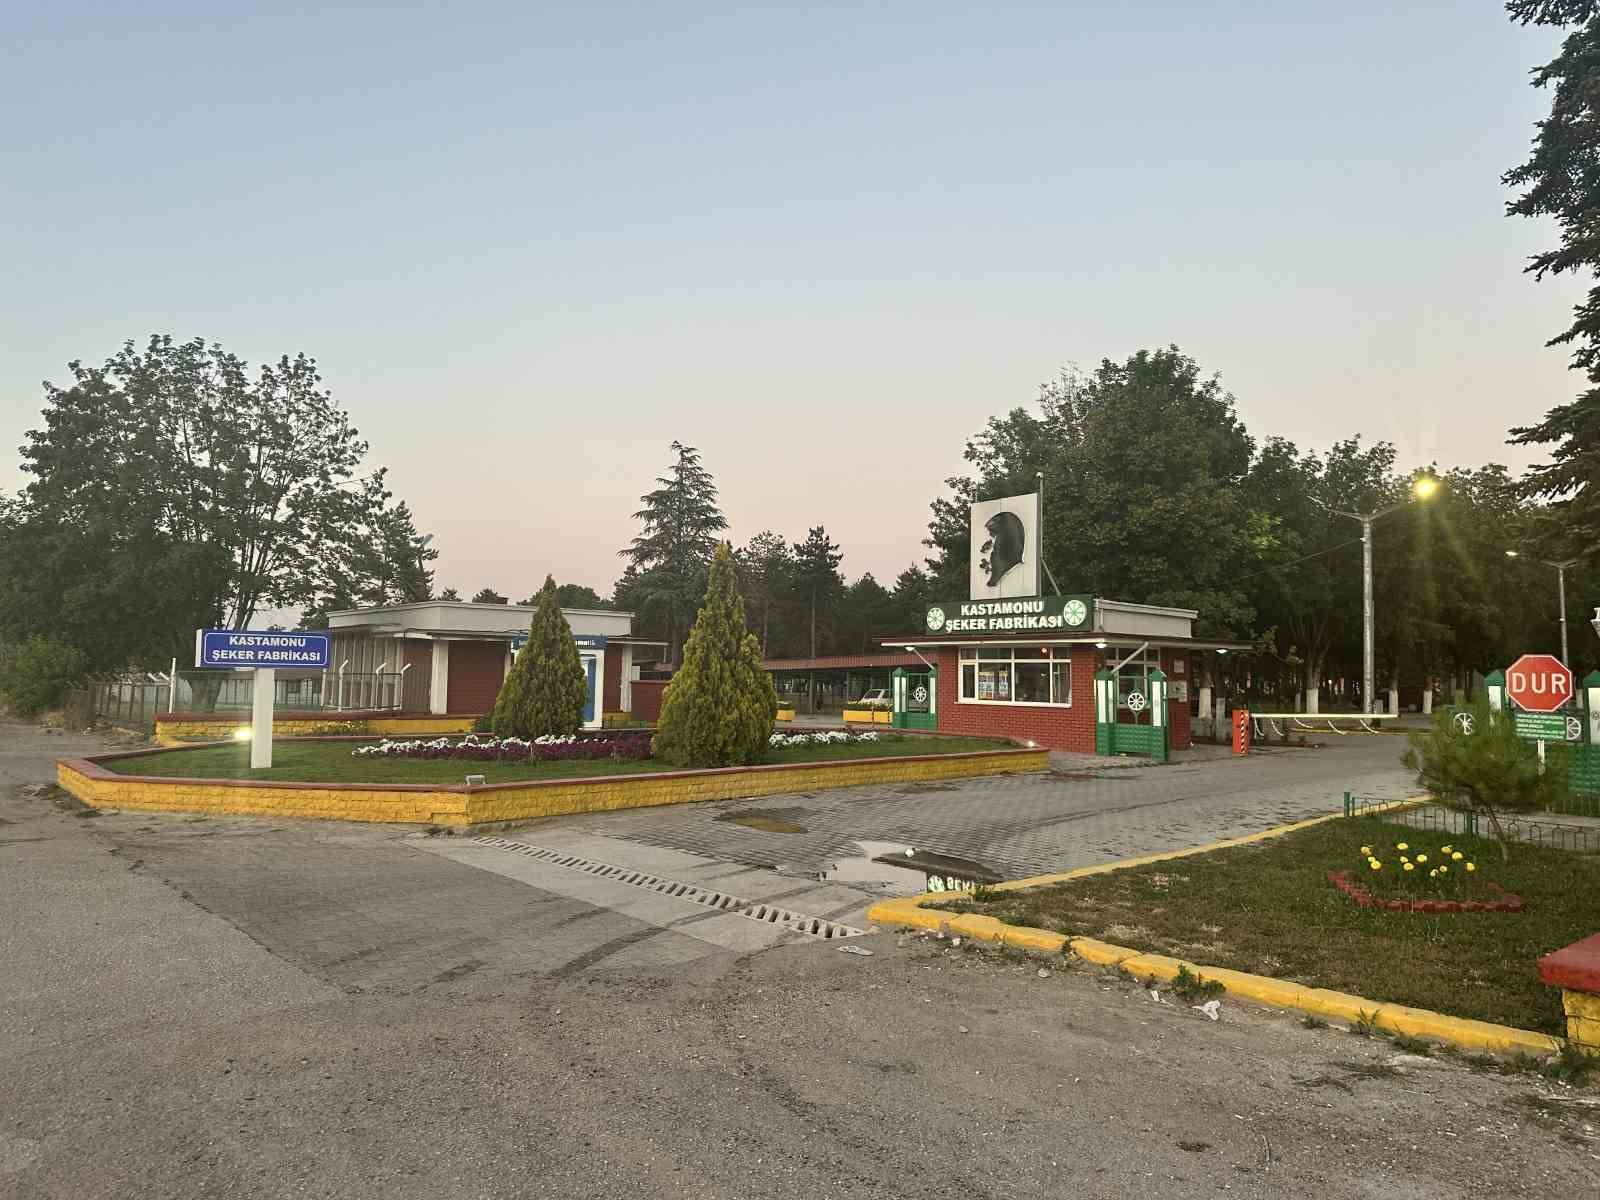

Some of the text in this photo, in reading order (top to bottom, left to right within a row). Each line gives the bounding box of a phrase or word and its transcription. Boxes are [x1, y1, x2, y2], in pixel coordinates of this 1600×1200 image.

[960, 600, 1044, 616] KASTAMONU
[945, 614, 1063, 633] ŞEKER FABRİKASI
[229, 636, 306, 647] KASTAMONU
[212, 649, 320, 661] ŞEKER FABRİKASI
[1511, 672, 1566, 694] DUR
